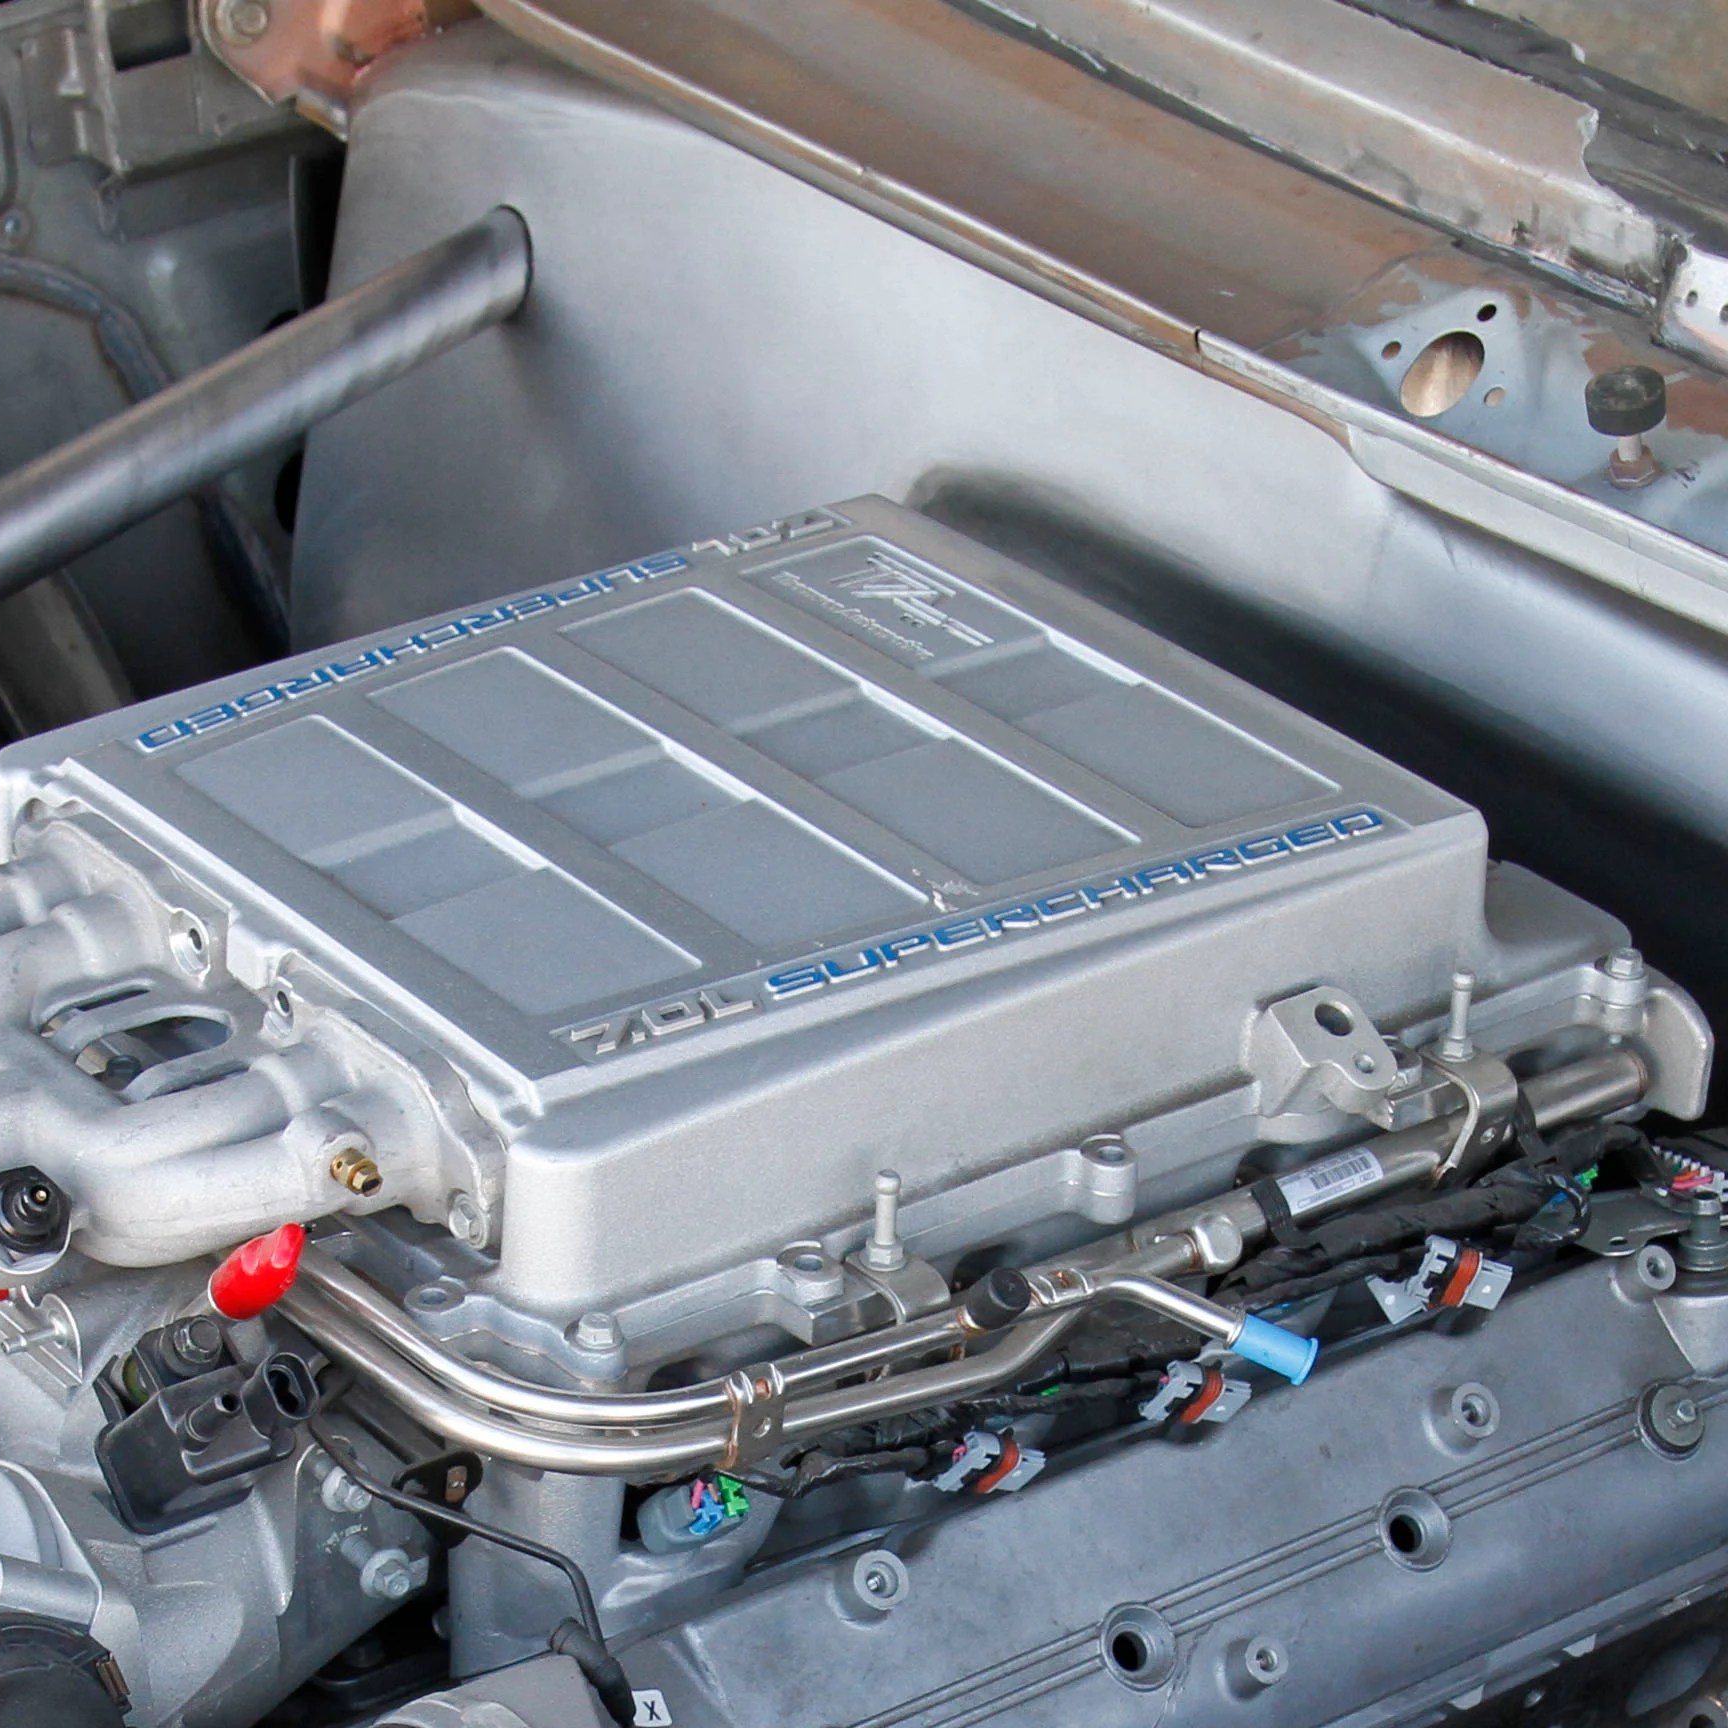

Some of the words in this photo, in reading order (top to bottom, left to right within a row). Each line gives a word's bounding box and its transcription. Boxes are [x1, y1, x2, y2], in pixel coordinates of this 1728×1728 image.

[136, 551, 689, 754] SUPERCHARGED
[571, 989, 754, 1055] 7.0L
[764, 809, 1384, 1001] SUPERCHARGED
